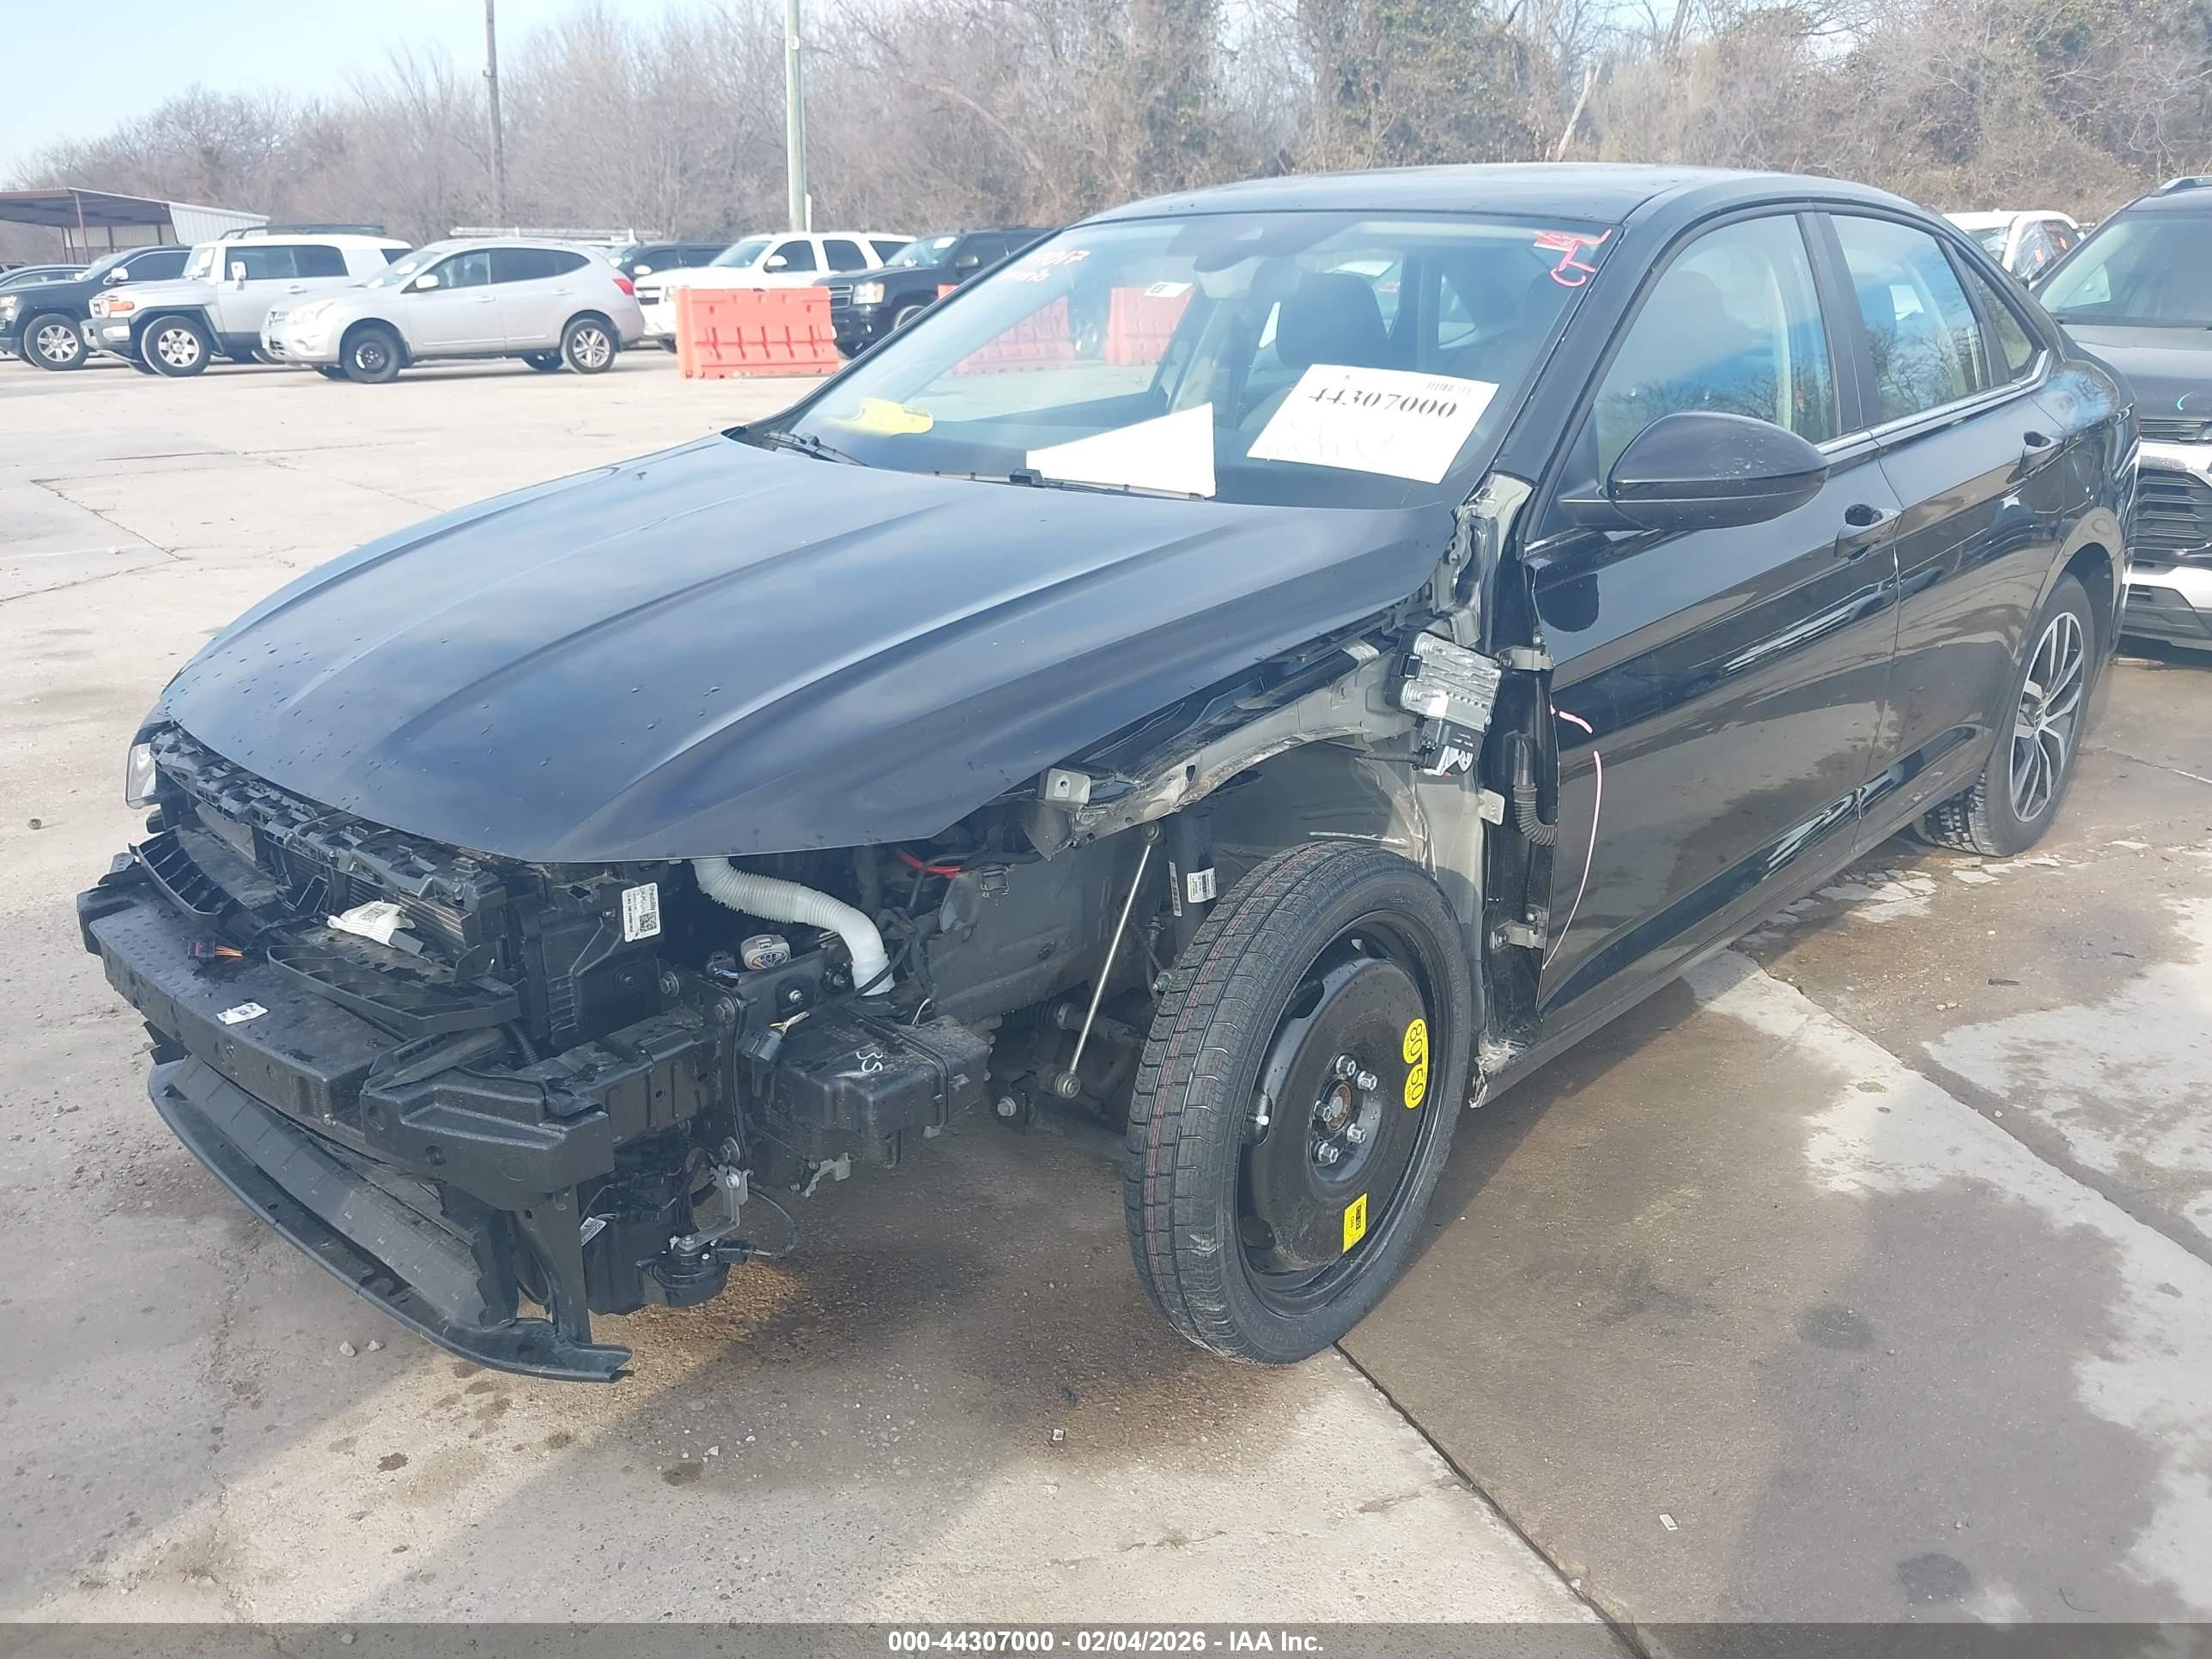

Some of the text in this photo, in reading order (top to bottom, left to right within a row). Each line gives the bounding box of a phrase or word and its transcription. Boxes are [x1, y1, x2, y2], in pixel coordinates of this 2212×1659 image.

[1307, 386, 1457, 418] 44307000
[1409, 1022, 1424, 1101] 80 50
